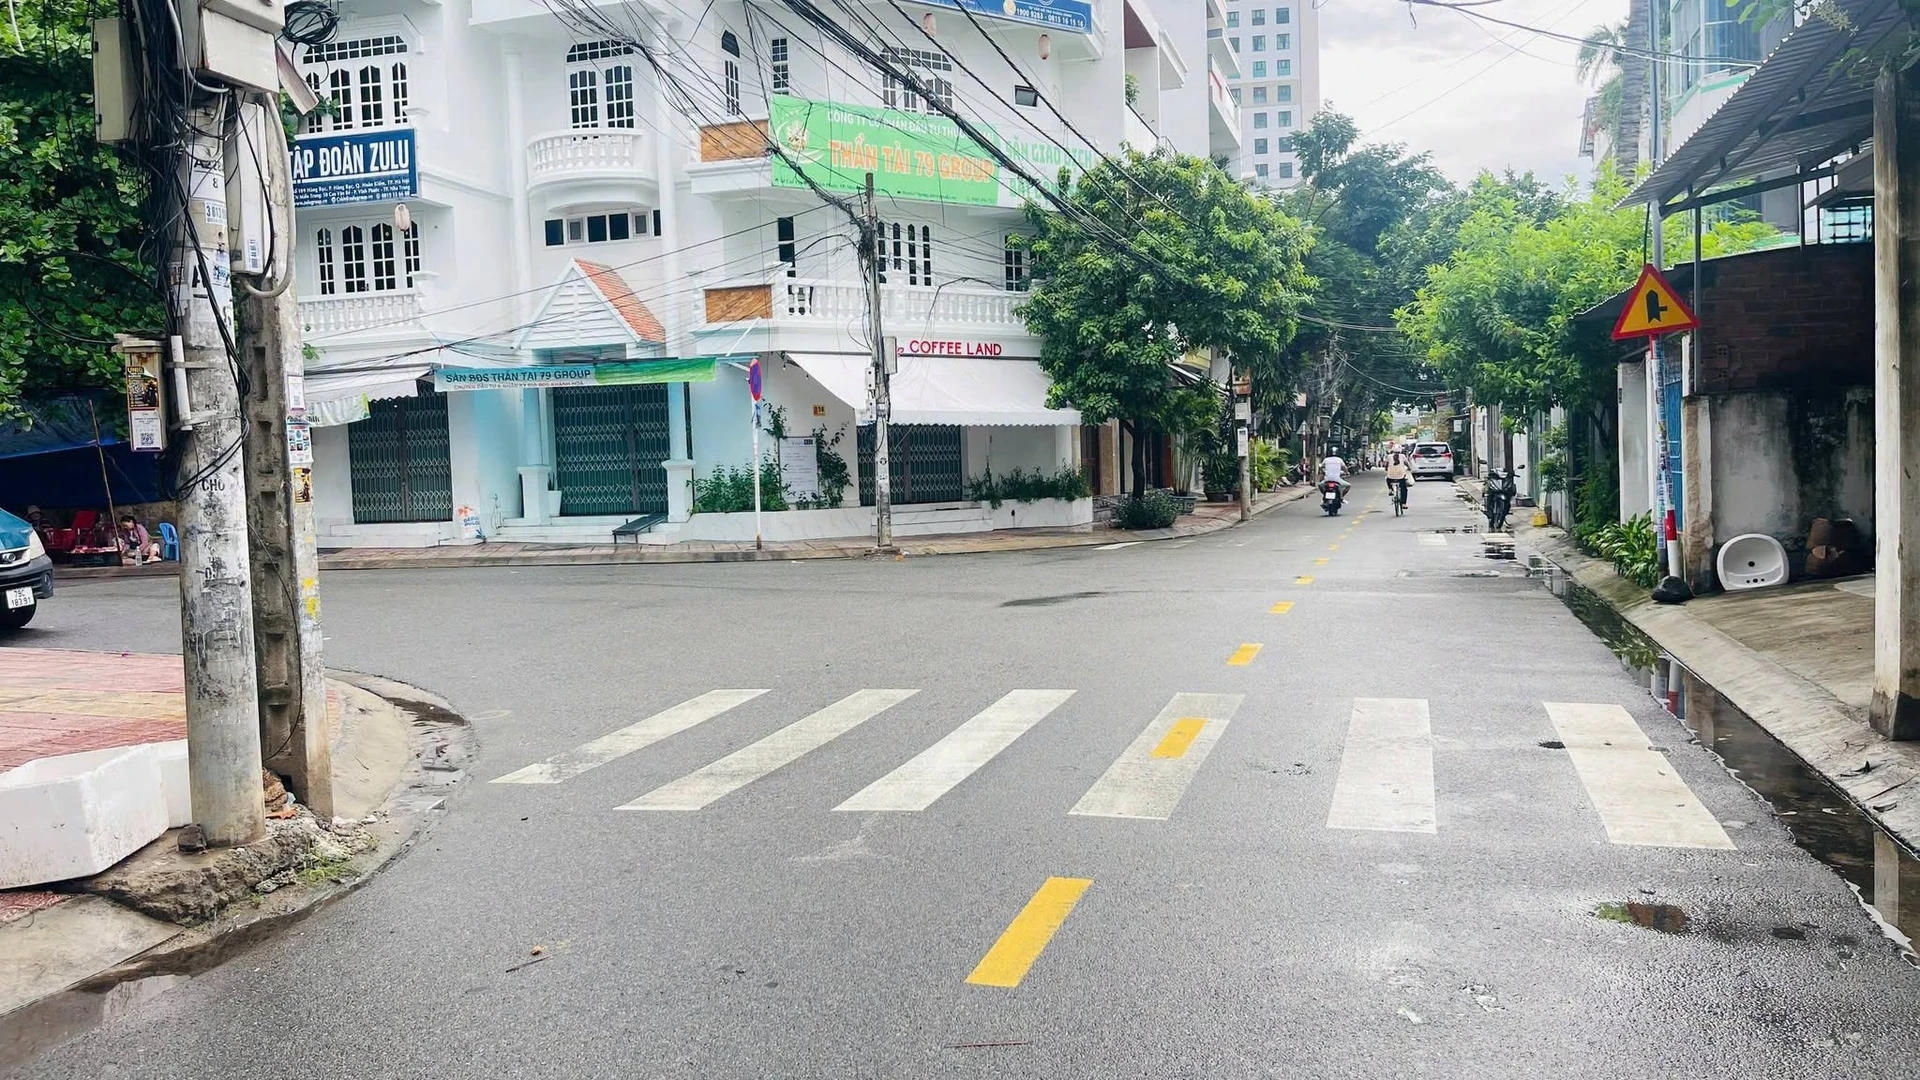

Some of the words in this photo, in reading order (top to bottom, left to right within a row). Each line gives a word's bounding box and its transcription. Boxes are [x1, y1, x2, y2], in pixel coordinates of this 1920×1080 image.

[827, 110, 854, 124] CÔNG
[857, 115, 866, 126] TY
[320, 141, 364, 176] ĐOÀN
[370, 140, 409, 172] ZULU
[882, 140, 910, 174] TÀI
[915, 152, 934, 177] 79
[938, 154, 994, 183] GROUP
[1032, 144, 1060, 165] GIAO
[910, 340, 962, 355] COFFEE
[966, 342, 1002, 356] LAND
[446, 371, 466, 382] SÀN
[554, 370, 591, 379] GROUP
